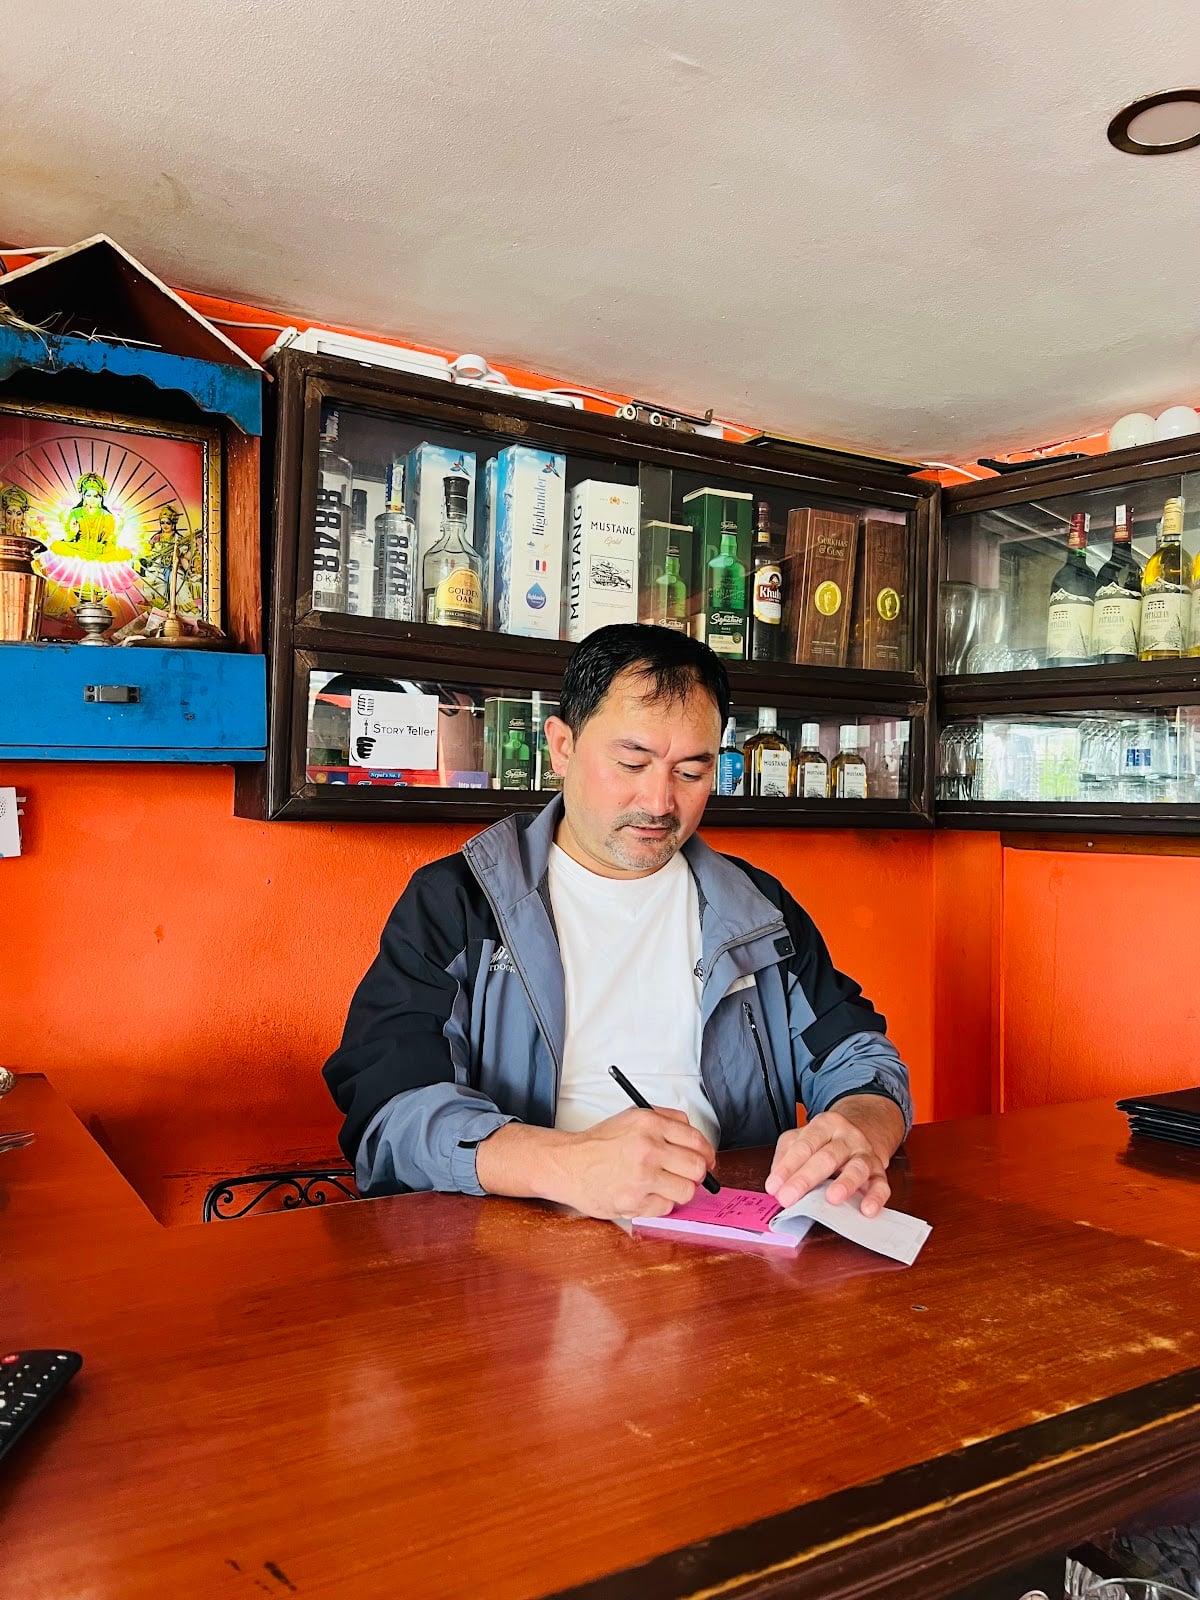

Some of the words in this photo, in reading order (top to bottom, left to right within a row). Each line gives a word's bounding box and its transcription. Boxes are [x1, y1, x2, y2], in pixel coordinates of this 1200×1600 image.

[531, 476, 548, 536] Highlander
[313, 488, 341, 573] 8848
[590, 521, 636, 536] MUSTANG
[386, 534, 408, 597] 8848
[570, 505, 582, 620] MUSTANG
[448, 587, 479, 598] GOLDEN
[456, 595, 473, 604] OAK
[406, 725, 435, 737] Teller
